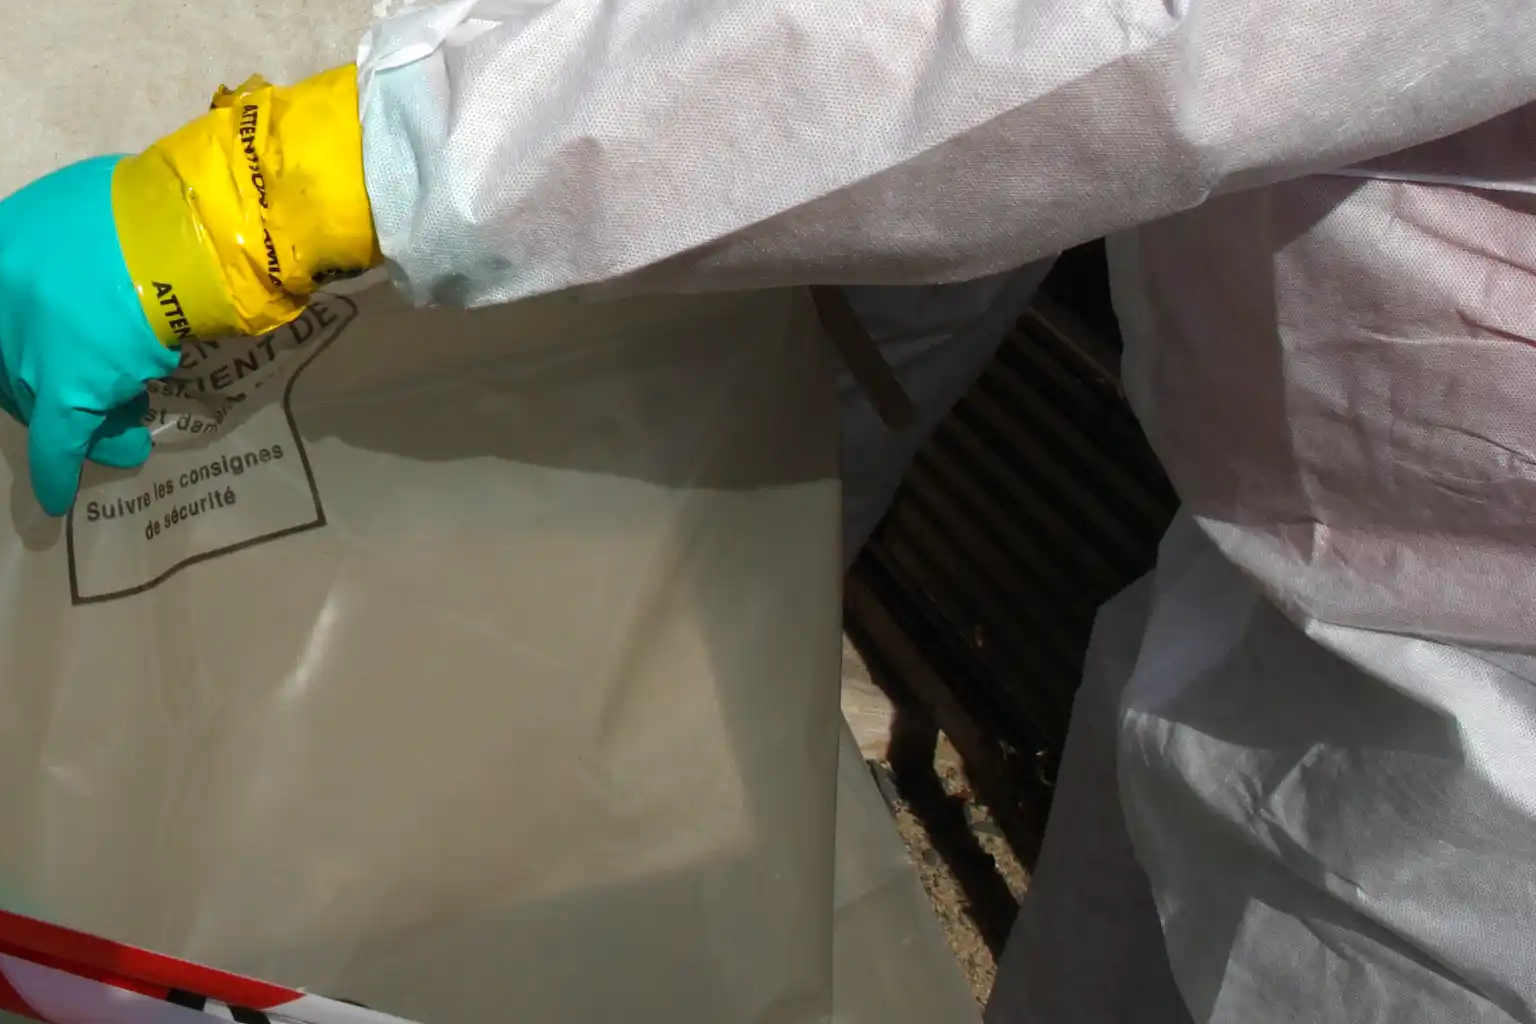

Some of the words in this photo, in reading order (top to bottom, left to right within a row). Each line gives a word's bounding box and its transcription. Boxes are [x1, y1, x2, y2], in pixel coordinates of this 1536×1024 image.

[288, 301, 338, 345] DE
[86, 491, 152, 522] Suivre
[153, 478, 175, 502] les
[179, 443, 284, 490] consignes
[144, 520, 161, 540] de
[164, 485, 237, 529] sécurité
